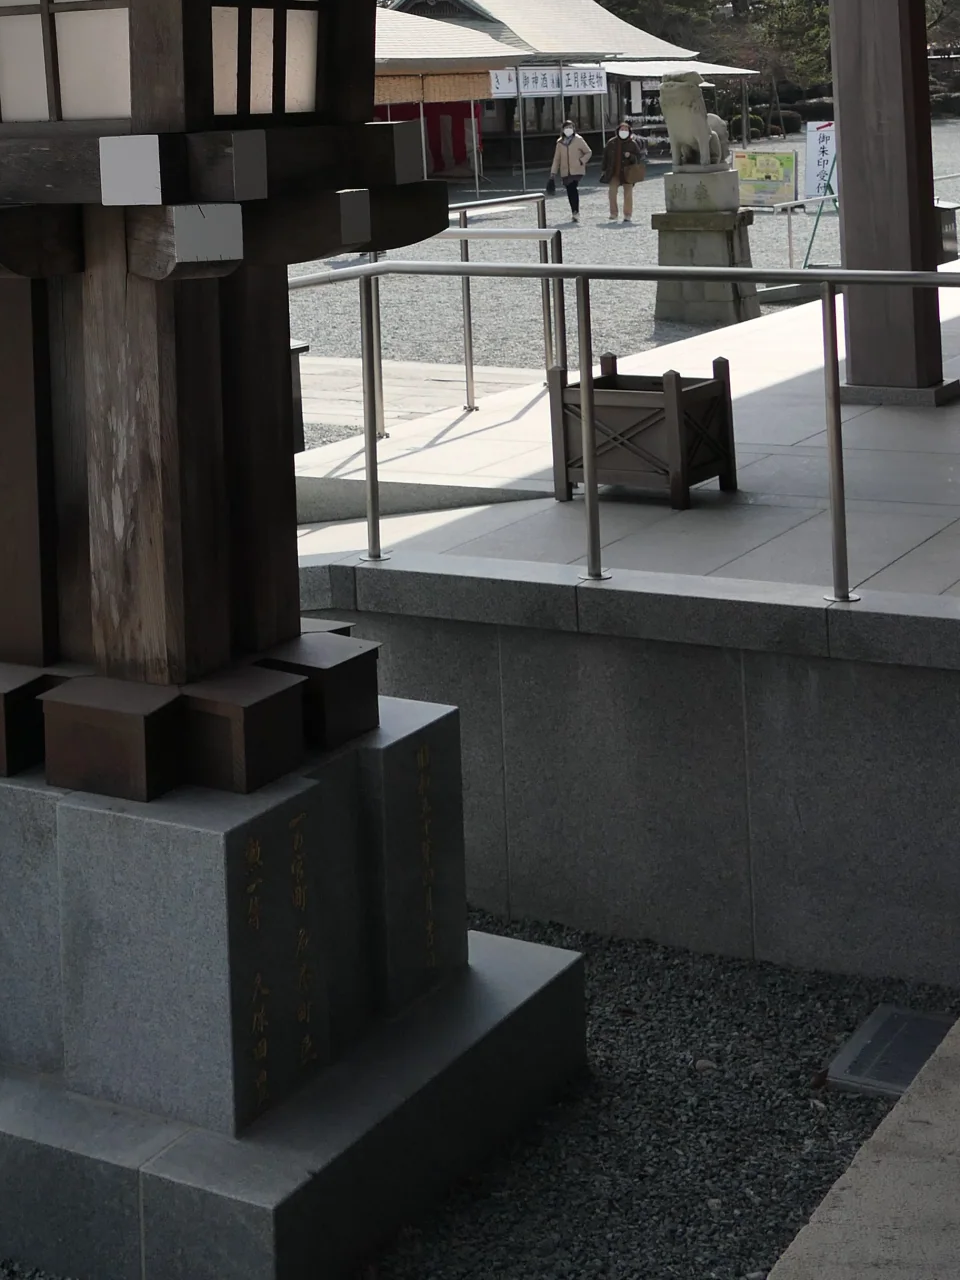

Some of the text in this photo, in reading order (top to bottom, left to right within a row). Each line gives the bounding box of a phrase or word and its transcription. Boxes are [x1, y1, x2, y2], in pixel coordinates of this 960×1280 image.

[565, 71, 603, 89] 正月縁起物
[816, 133, 831, 194] 御朱印受付
